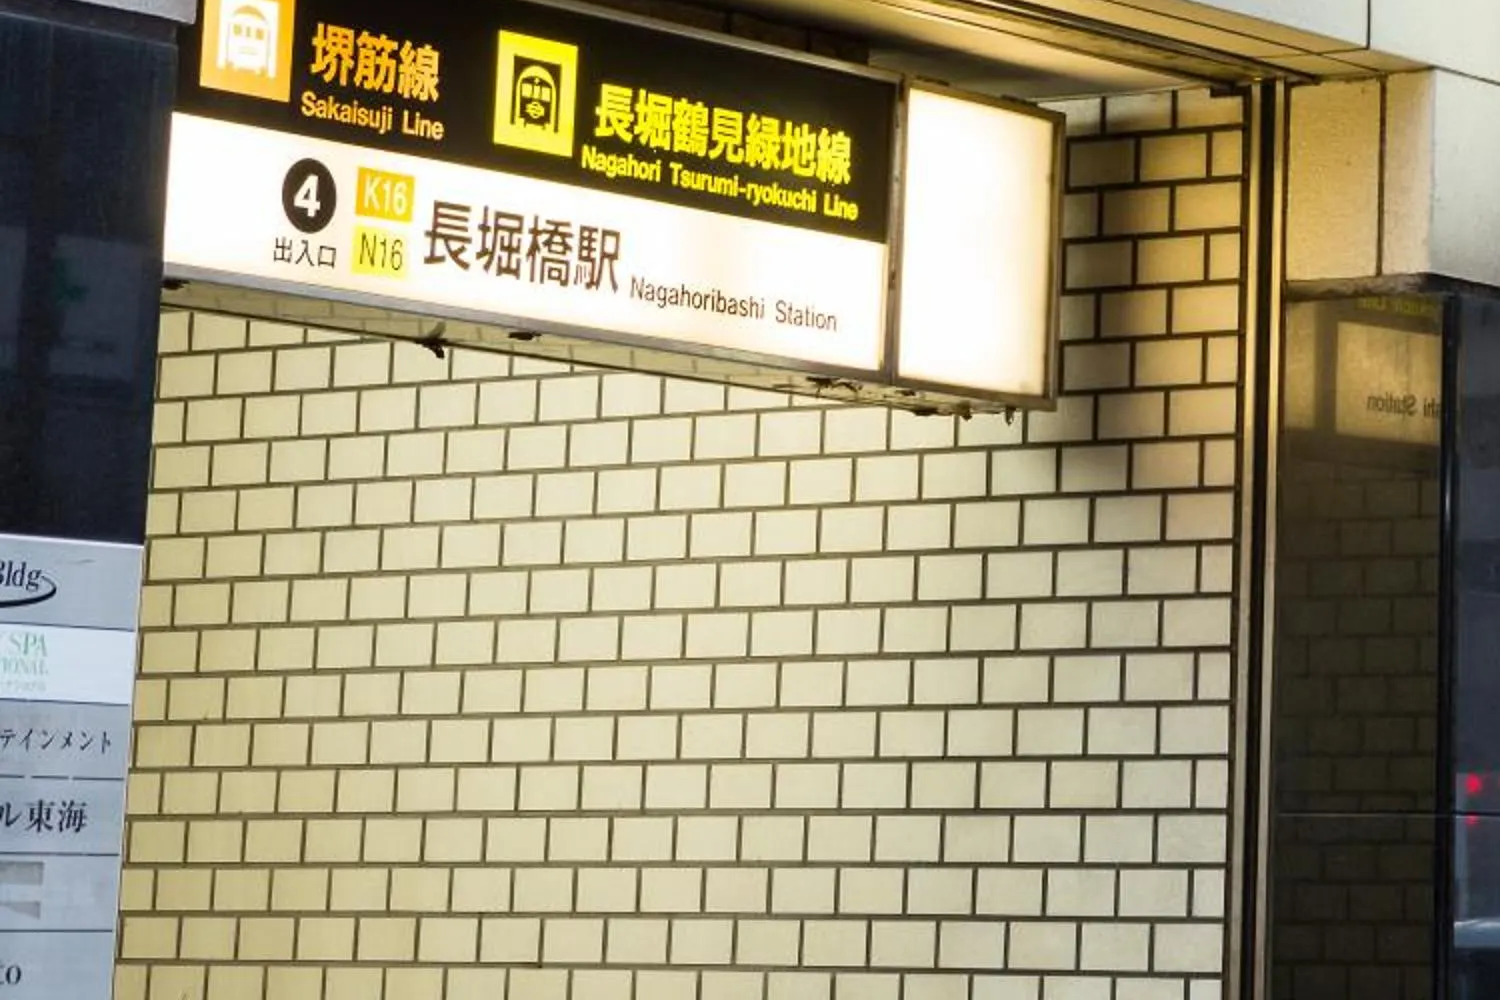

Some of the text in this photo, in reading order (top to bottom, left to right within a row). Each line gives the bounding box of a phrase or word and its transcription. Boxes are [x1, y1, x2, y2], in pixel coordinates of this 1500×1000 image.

[311, 22, 440, 102] 堺筋線
[301, 91, 445, 140] Sakaisuji Line
[594, 83, 852, 185] 長堀鶴見緑地線
[293, 173, 321, 218] 4
[364, 173, 409, 217] K16
[581, 145, 859, 221] Nagahori Tsurumi-ryokuchi Line
[273, 236, 337, 269] 出入口
[359, 232, 404, 271] N16
[423, 200, 838, 333] 長堀橋駅 Nagahoribashi Station
